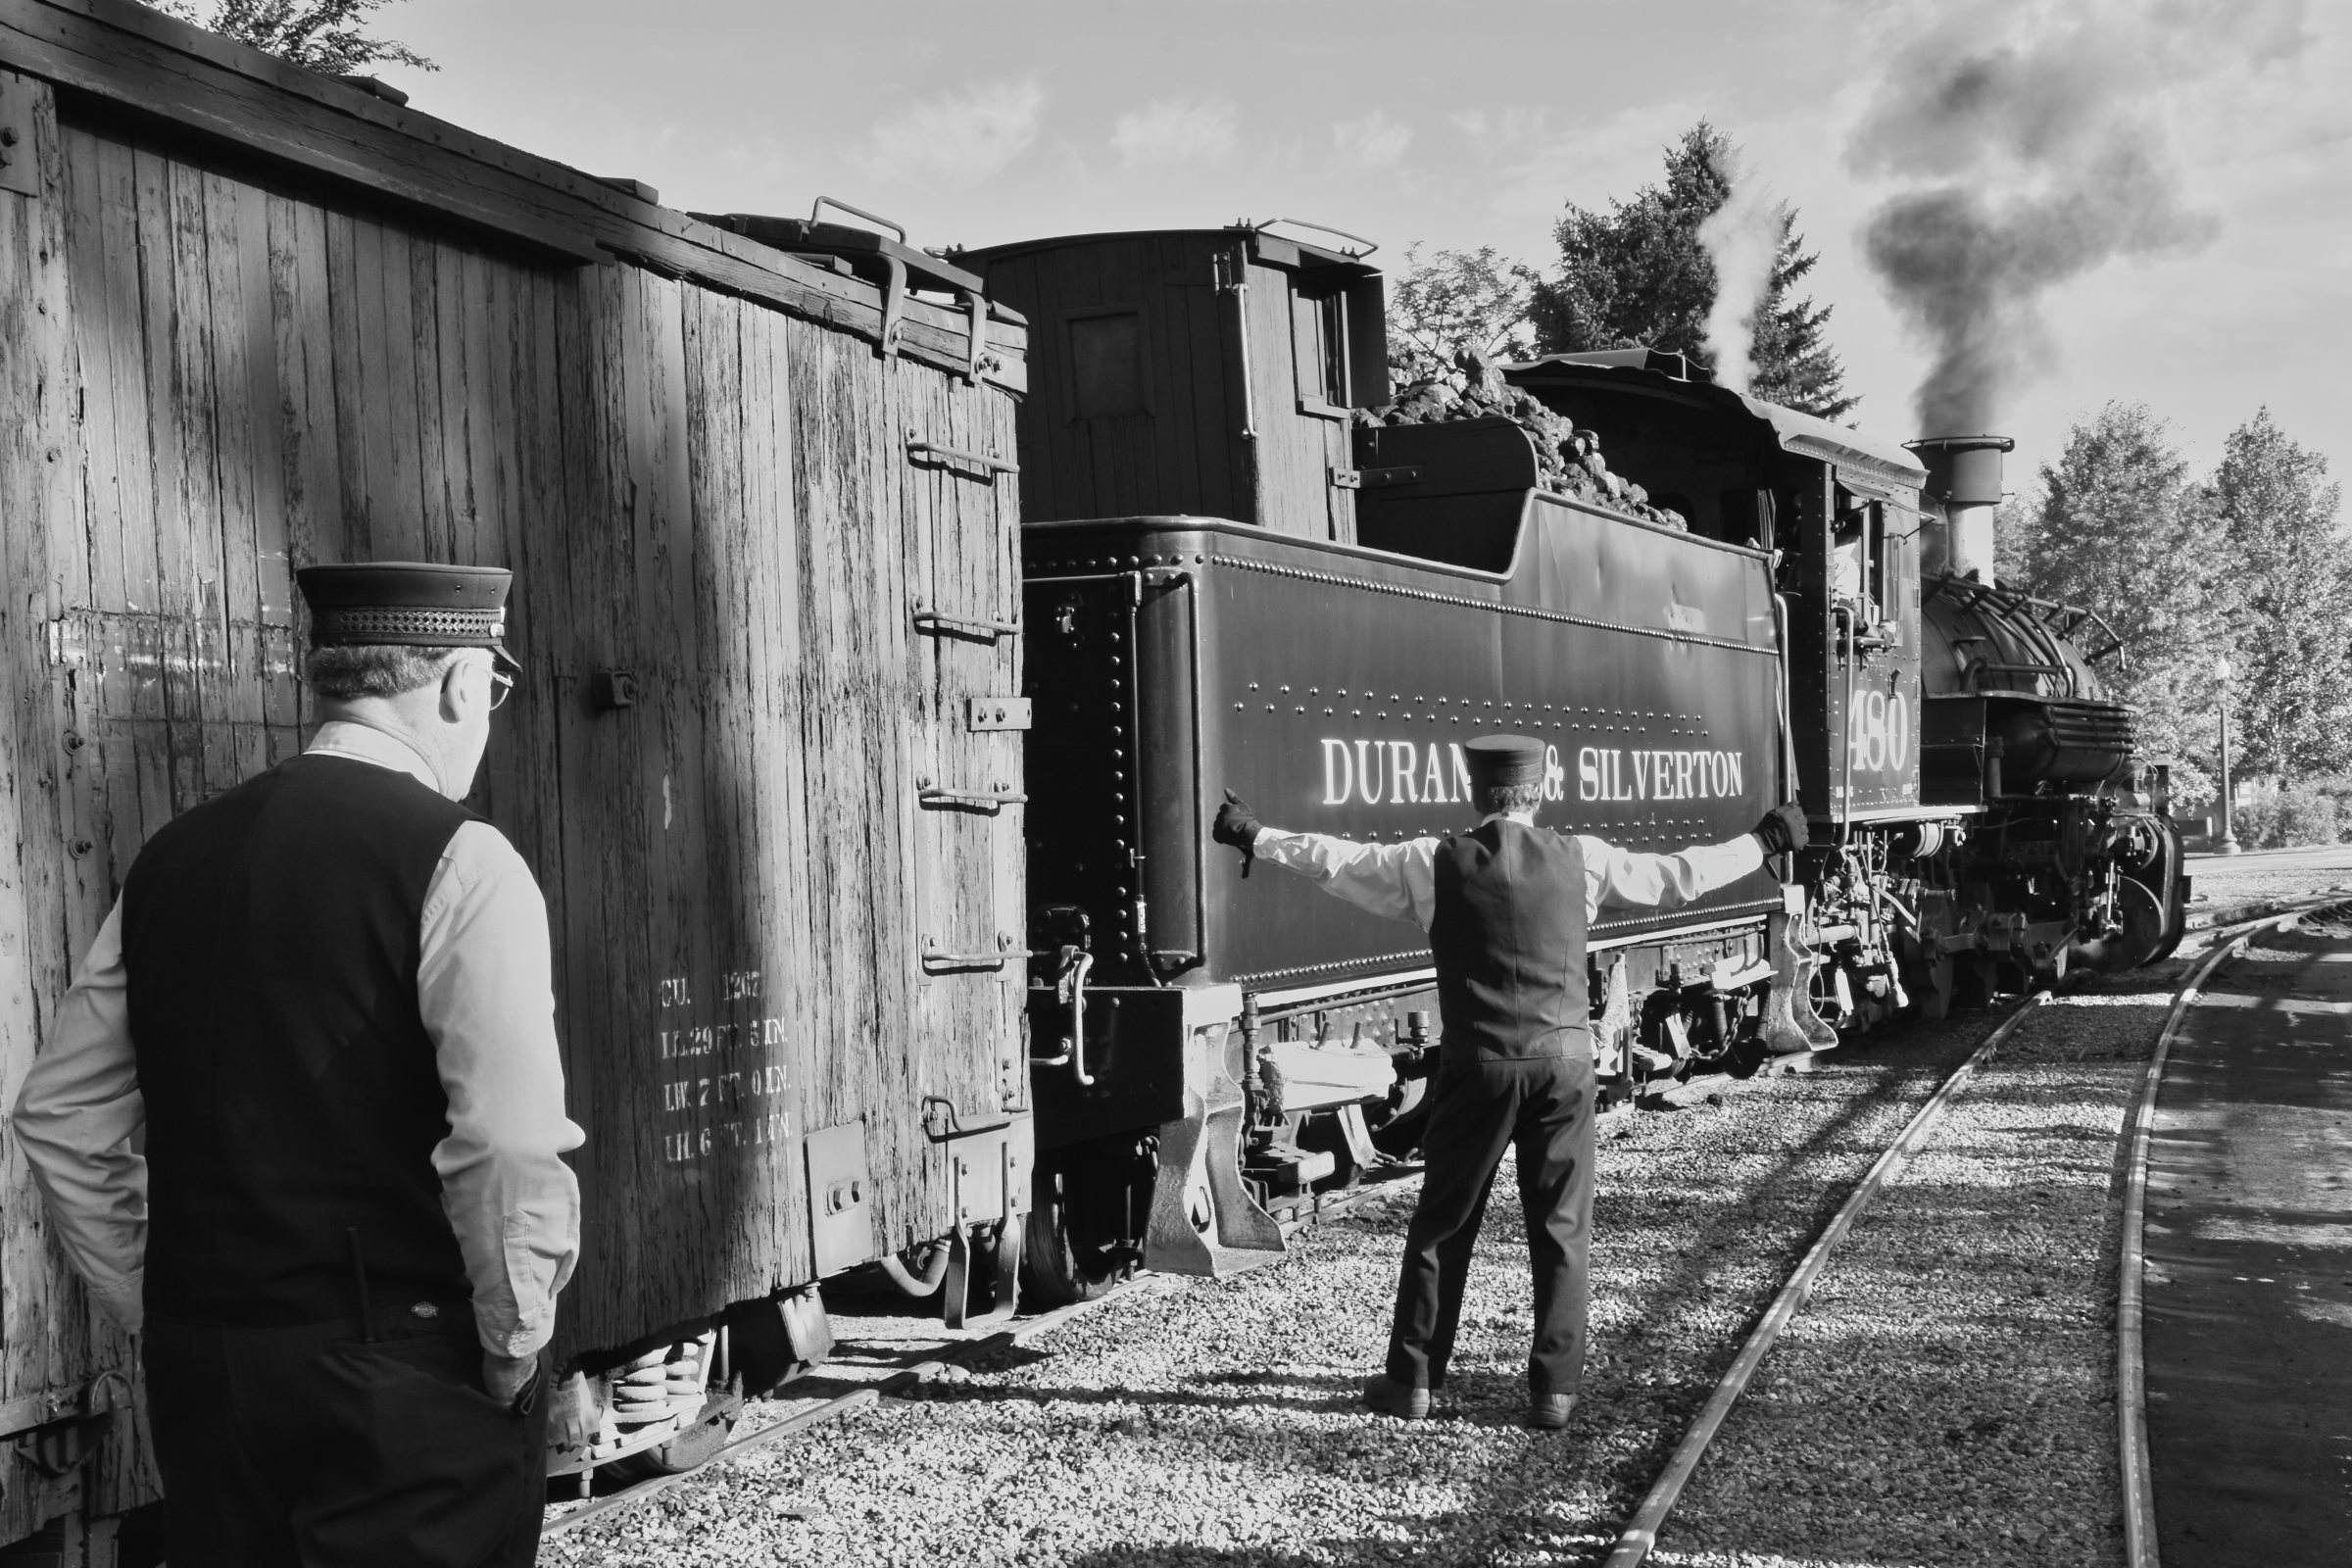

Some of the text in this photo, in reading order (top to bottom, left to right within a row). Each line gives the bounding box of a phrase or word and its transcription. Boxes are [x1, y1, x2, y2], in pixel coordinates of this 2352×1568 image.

[1849, 690, 1908, 771] 480
[1321, 738, 1742, 805] DURAN & SILVERTON
[763, 1017, 788, 1045] IN.
[699, 1078, 710, 1106] 7
[764, 1065, 791, 1095] IN.
